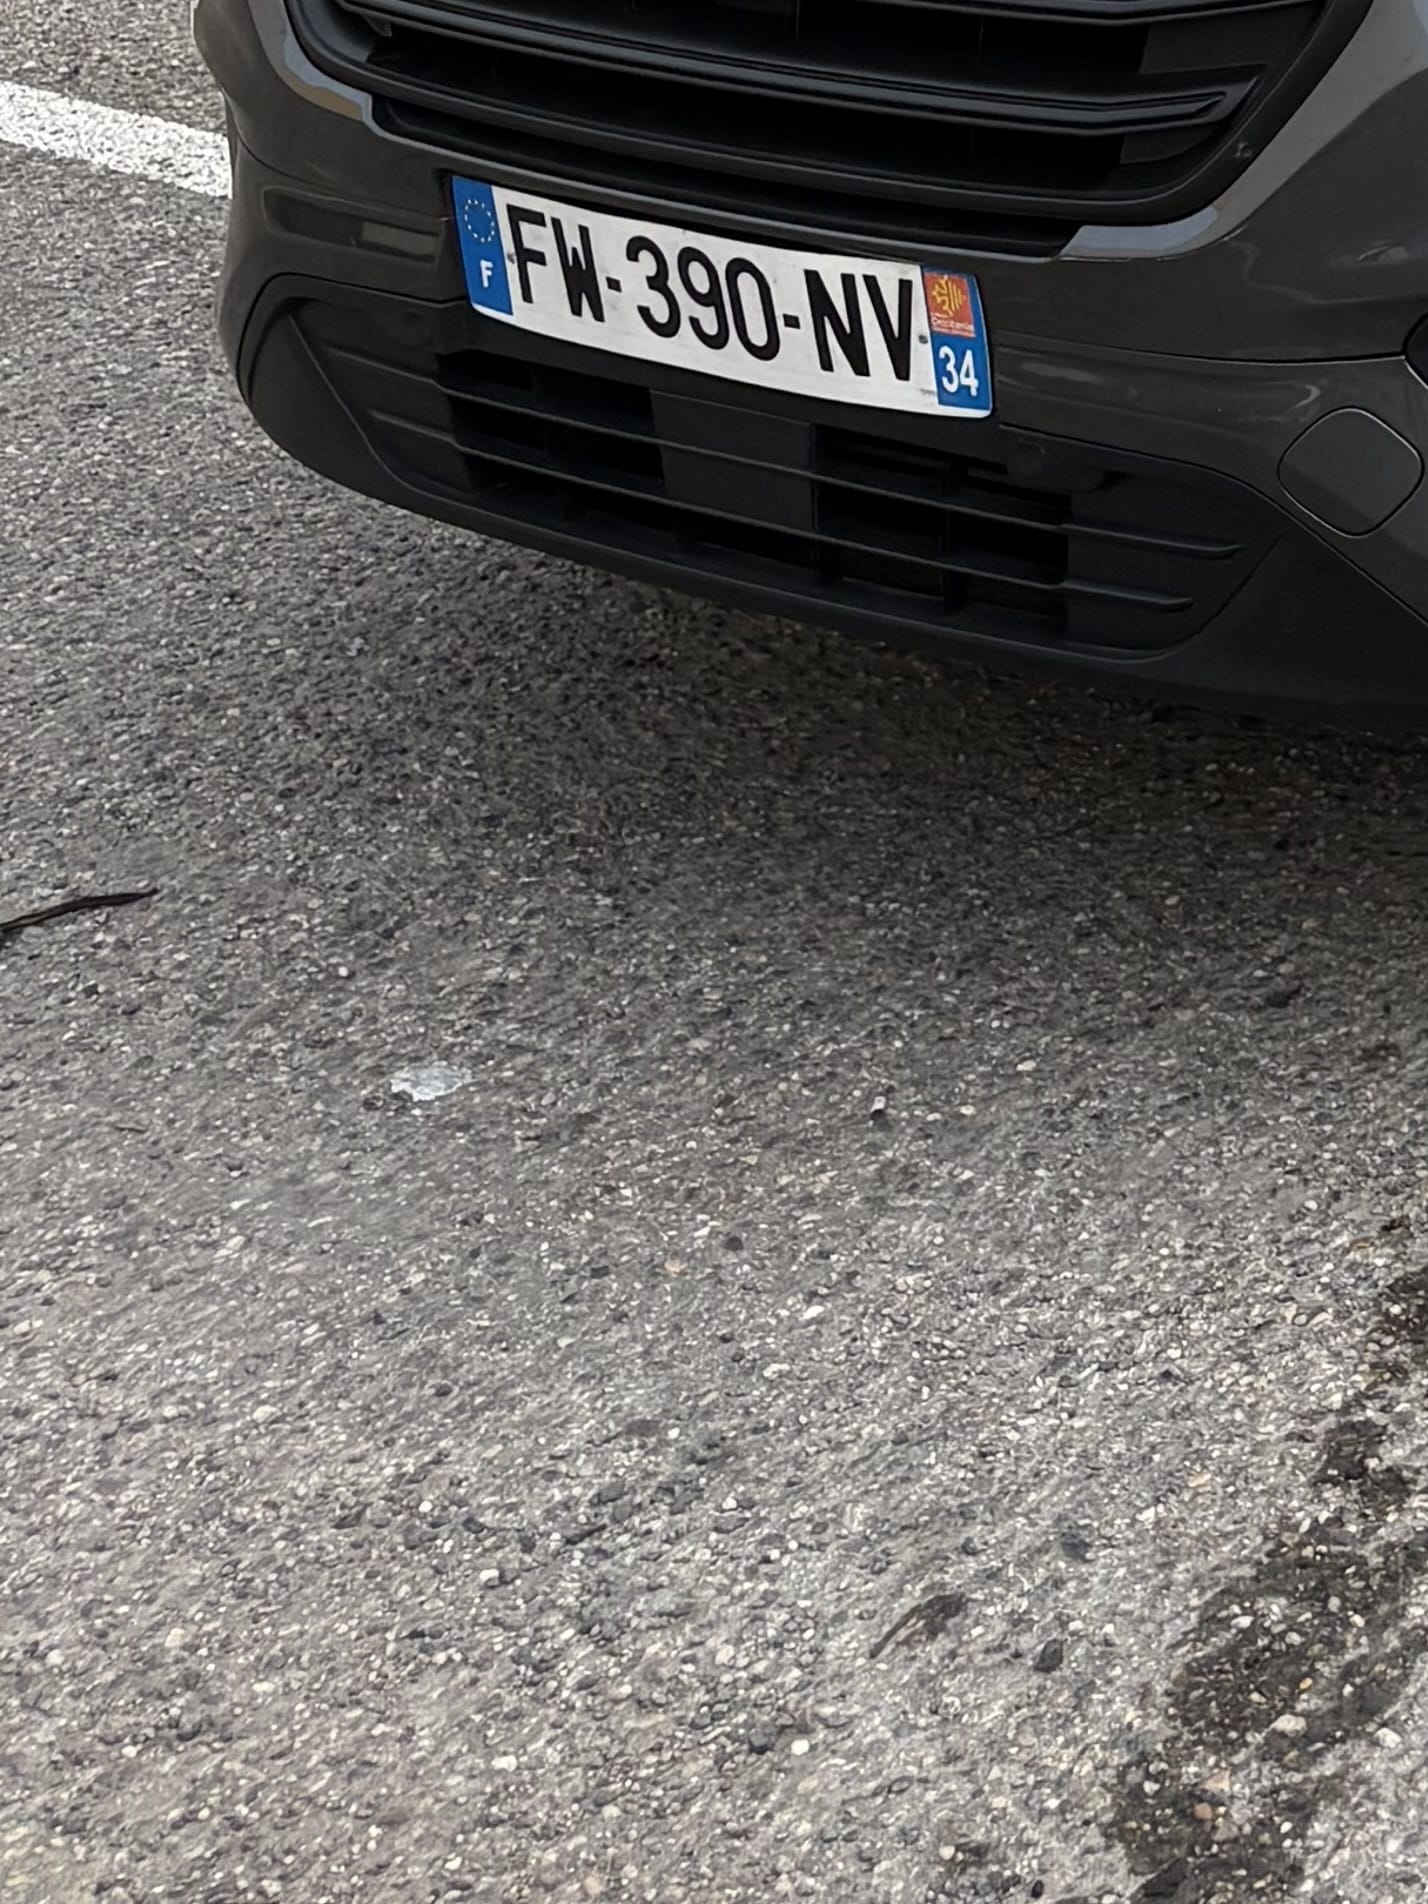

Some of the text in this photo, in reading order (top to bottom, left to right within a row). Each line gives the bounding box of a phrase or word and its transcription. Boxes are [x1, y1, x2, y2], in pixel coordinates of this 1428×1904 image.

[480, 259, 494, 288] F
[506, 202, 914, 382] FW-390-NV
[938, 344, 979, 397] 34
